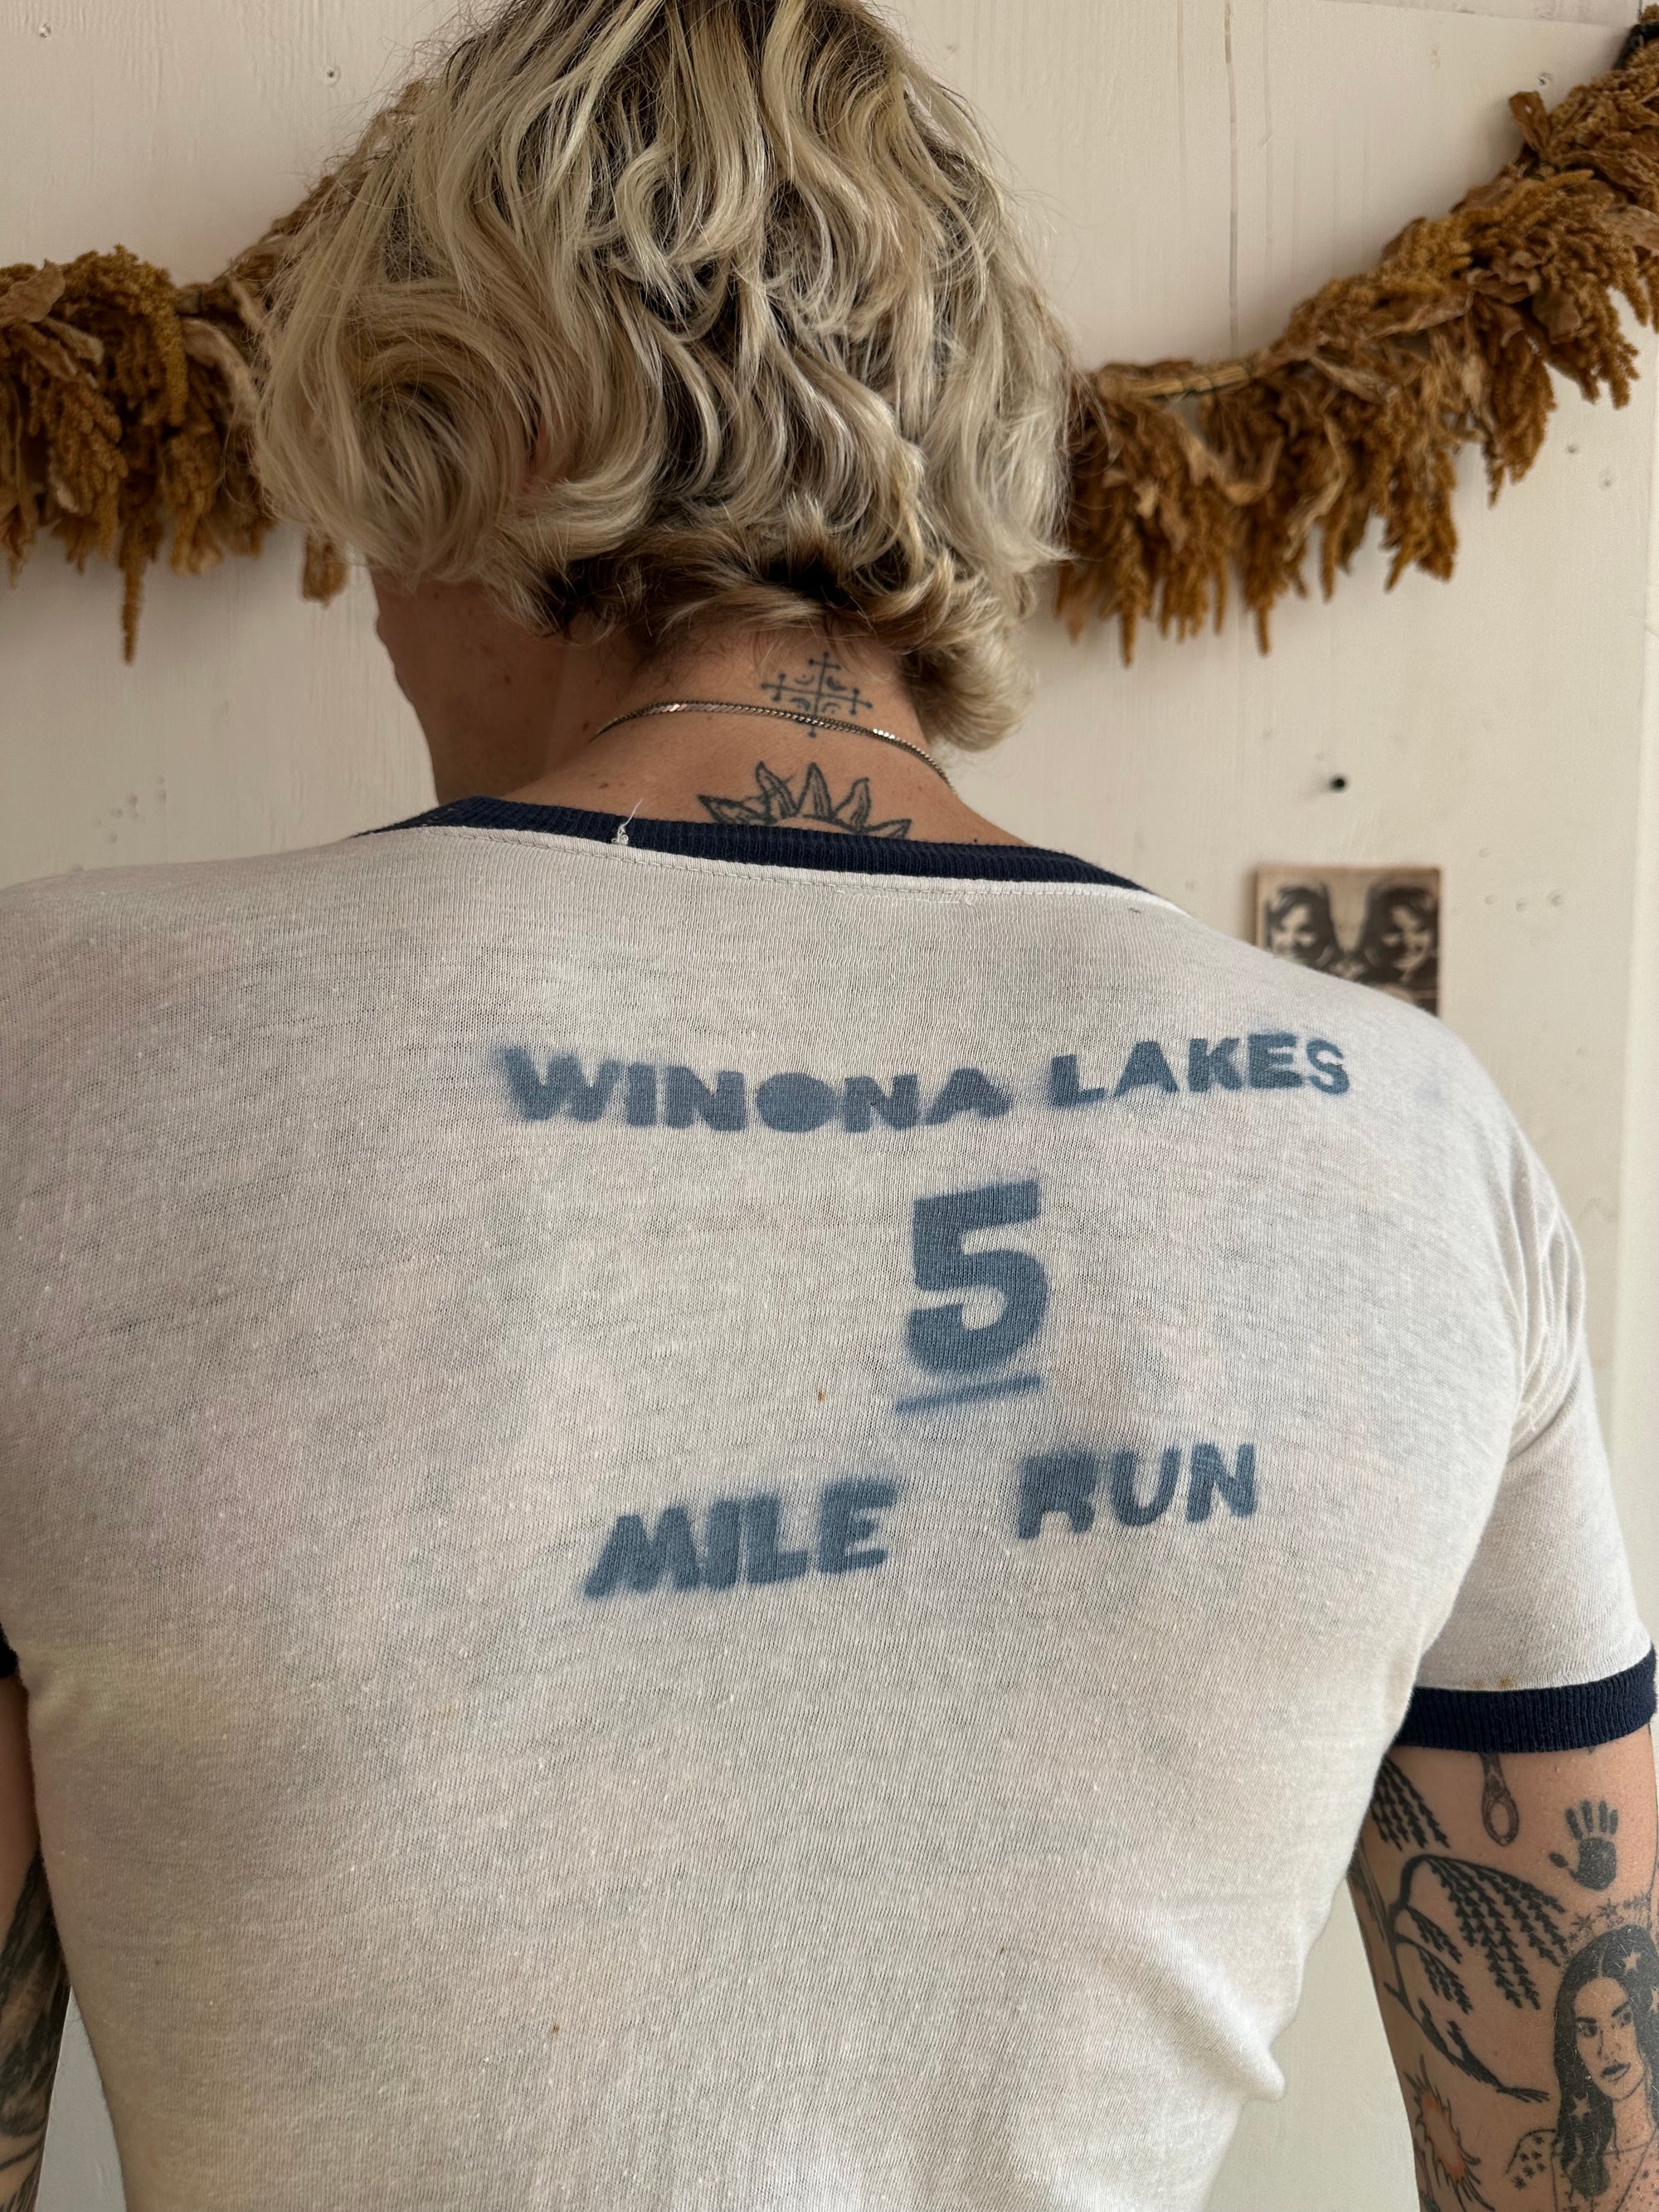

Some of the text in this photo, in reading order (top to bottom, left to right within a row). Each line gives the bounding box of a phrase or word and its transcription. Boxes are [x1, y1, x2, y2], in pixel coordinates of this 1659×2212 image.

[499, 1032, 1350, 1133] WINONA LAKES
[904, 1179, 1049, 1373] 5
[584, 1441, 1259, 1598] MILE RUN
